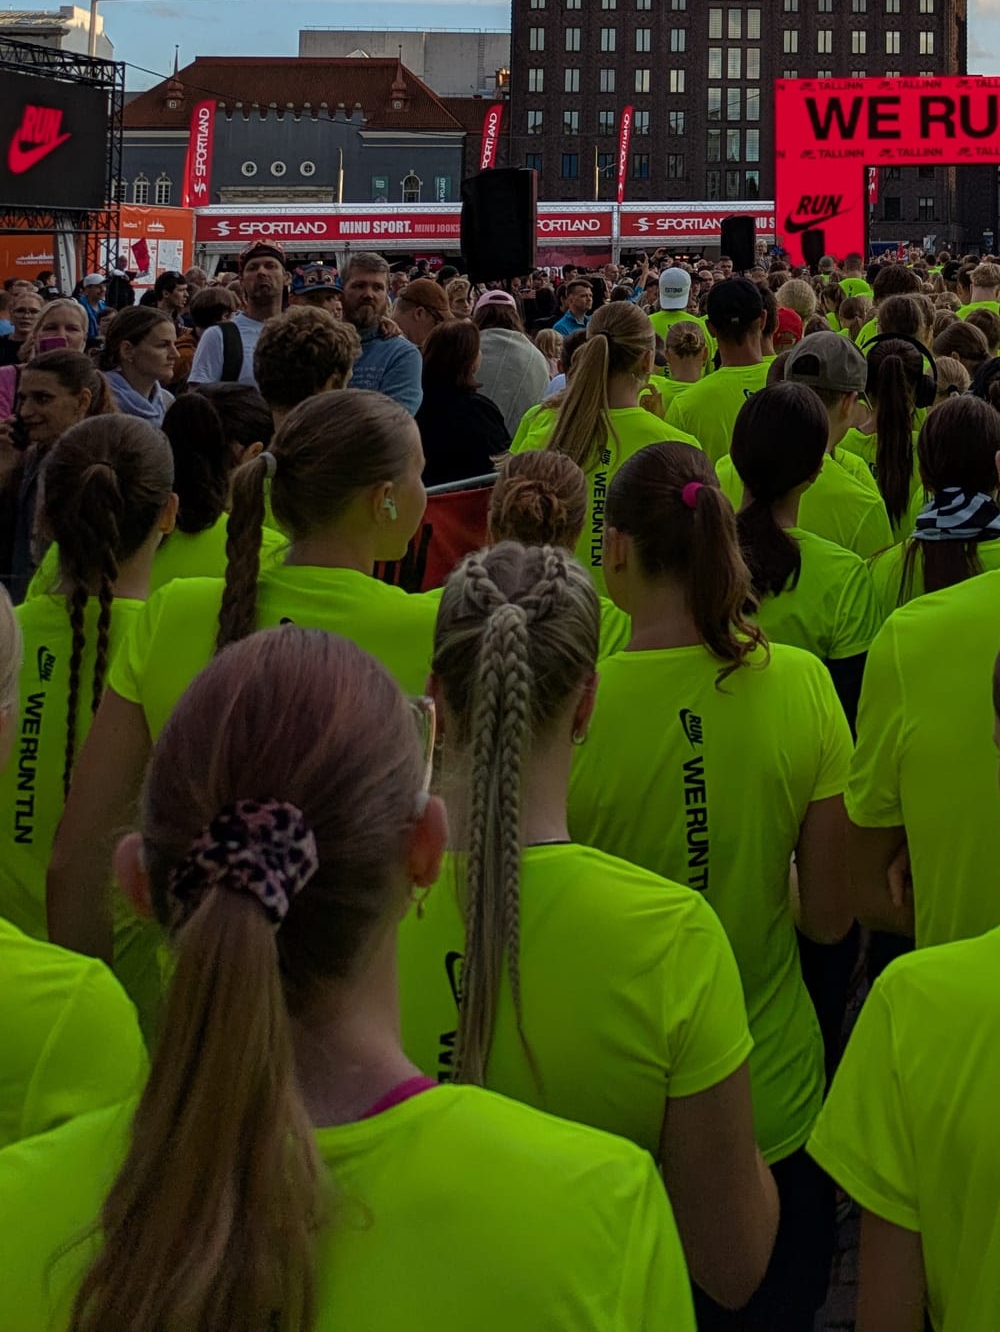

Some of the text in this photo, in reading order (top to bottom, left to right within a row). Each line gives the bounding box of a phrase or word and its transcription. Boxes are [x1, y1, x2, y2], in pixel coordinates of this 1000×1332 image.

[818, 82, 864, 90] TALLINN
[896, 80, 942, 88] TALLINN
[19, 104, 63, 145] RUN
[805, 96, 901, 140] WE
[196, 108, 210, 176] SPORTLAND
[818, 149, 864, 158] TALLINN
[897, 148, 943, 157] TALLINN
[797, 195, 842, 215] RUN
[238, 221, 327, 235] SPORTLAND
[339, 221, 370, 234] MINU
[373, 220, 412, 233] SPORT.
[414, 224, 435, 233] MINU
[40, 653, 56, 682] RUN
[689, 714, 704, 744] RUN
